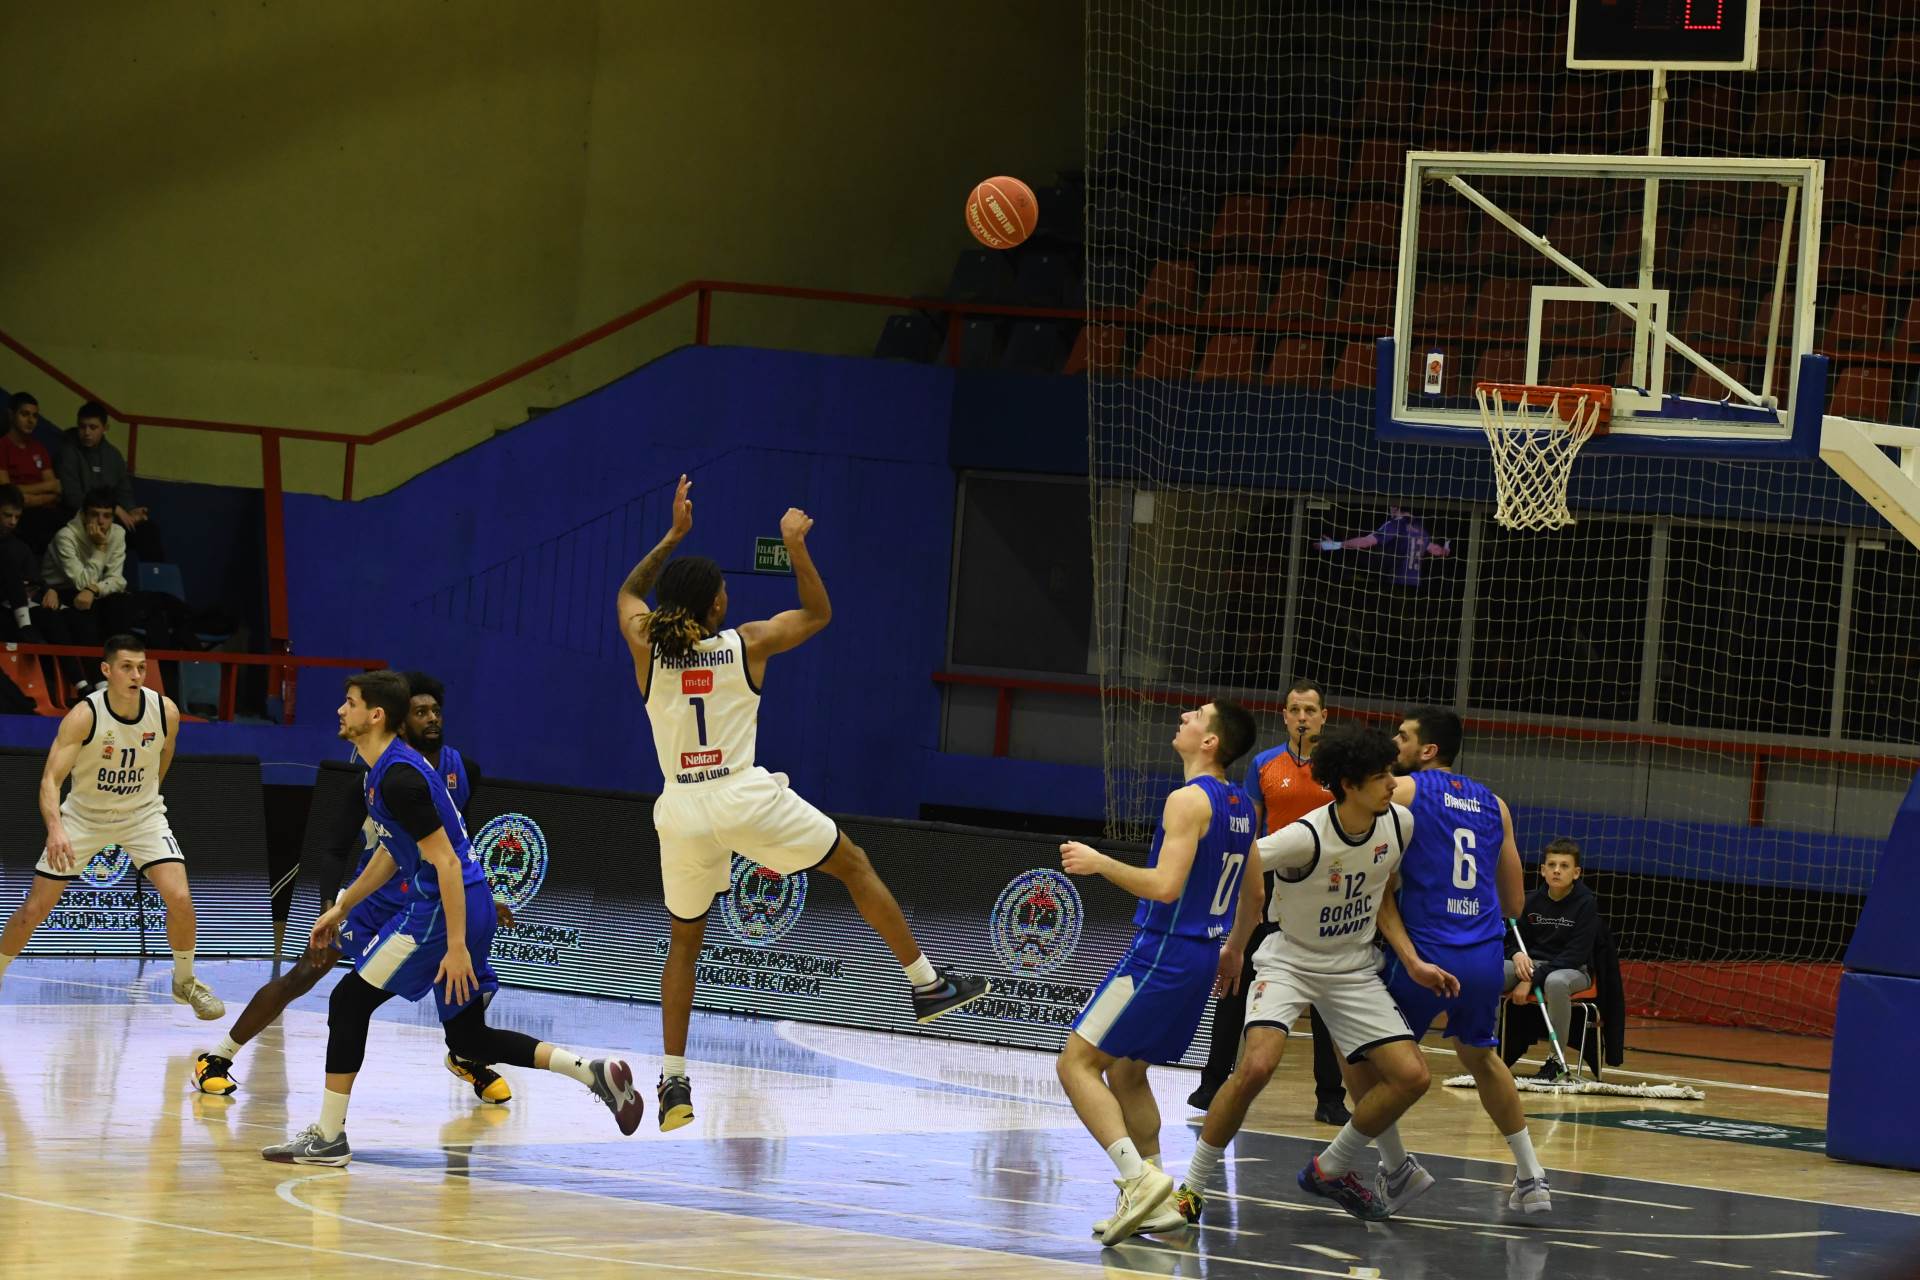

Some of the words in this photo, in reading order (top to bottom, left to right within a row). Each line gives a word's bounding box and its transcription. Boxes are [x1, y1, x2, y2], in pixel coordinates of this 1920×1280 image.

[970, 202, 1002, 246] SPALDING
[759, 556, 773, 565] EXIT
[685, 676, 710, 687] m:tel
[689, 697, 707, 746] 1
[120, 748, 136, 768] 11
[684, 753, 719, 766] Nektar
[97, 767, 145, 784] BORAC
[676, 771, 705, 783] BANJA
[705, 767, 730, 780] LUKA
[1452, 828, 1477, 890] 6
[1344, 871, 1366, 900] 12
[1319, 895, 1372, 924] BORAC
[1446, 896, 1480, 916] NIKŠIĆ
